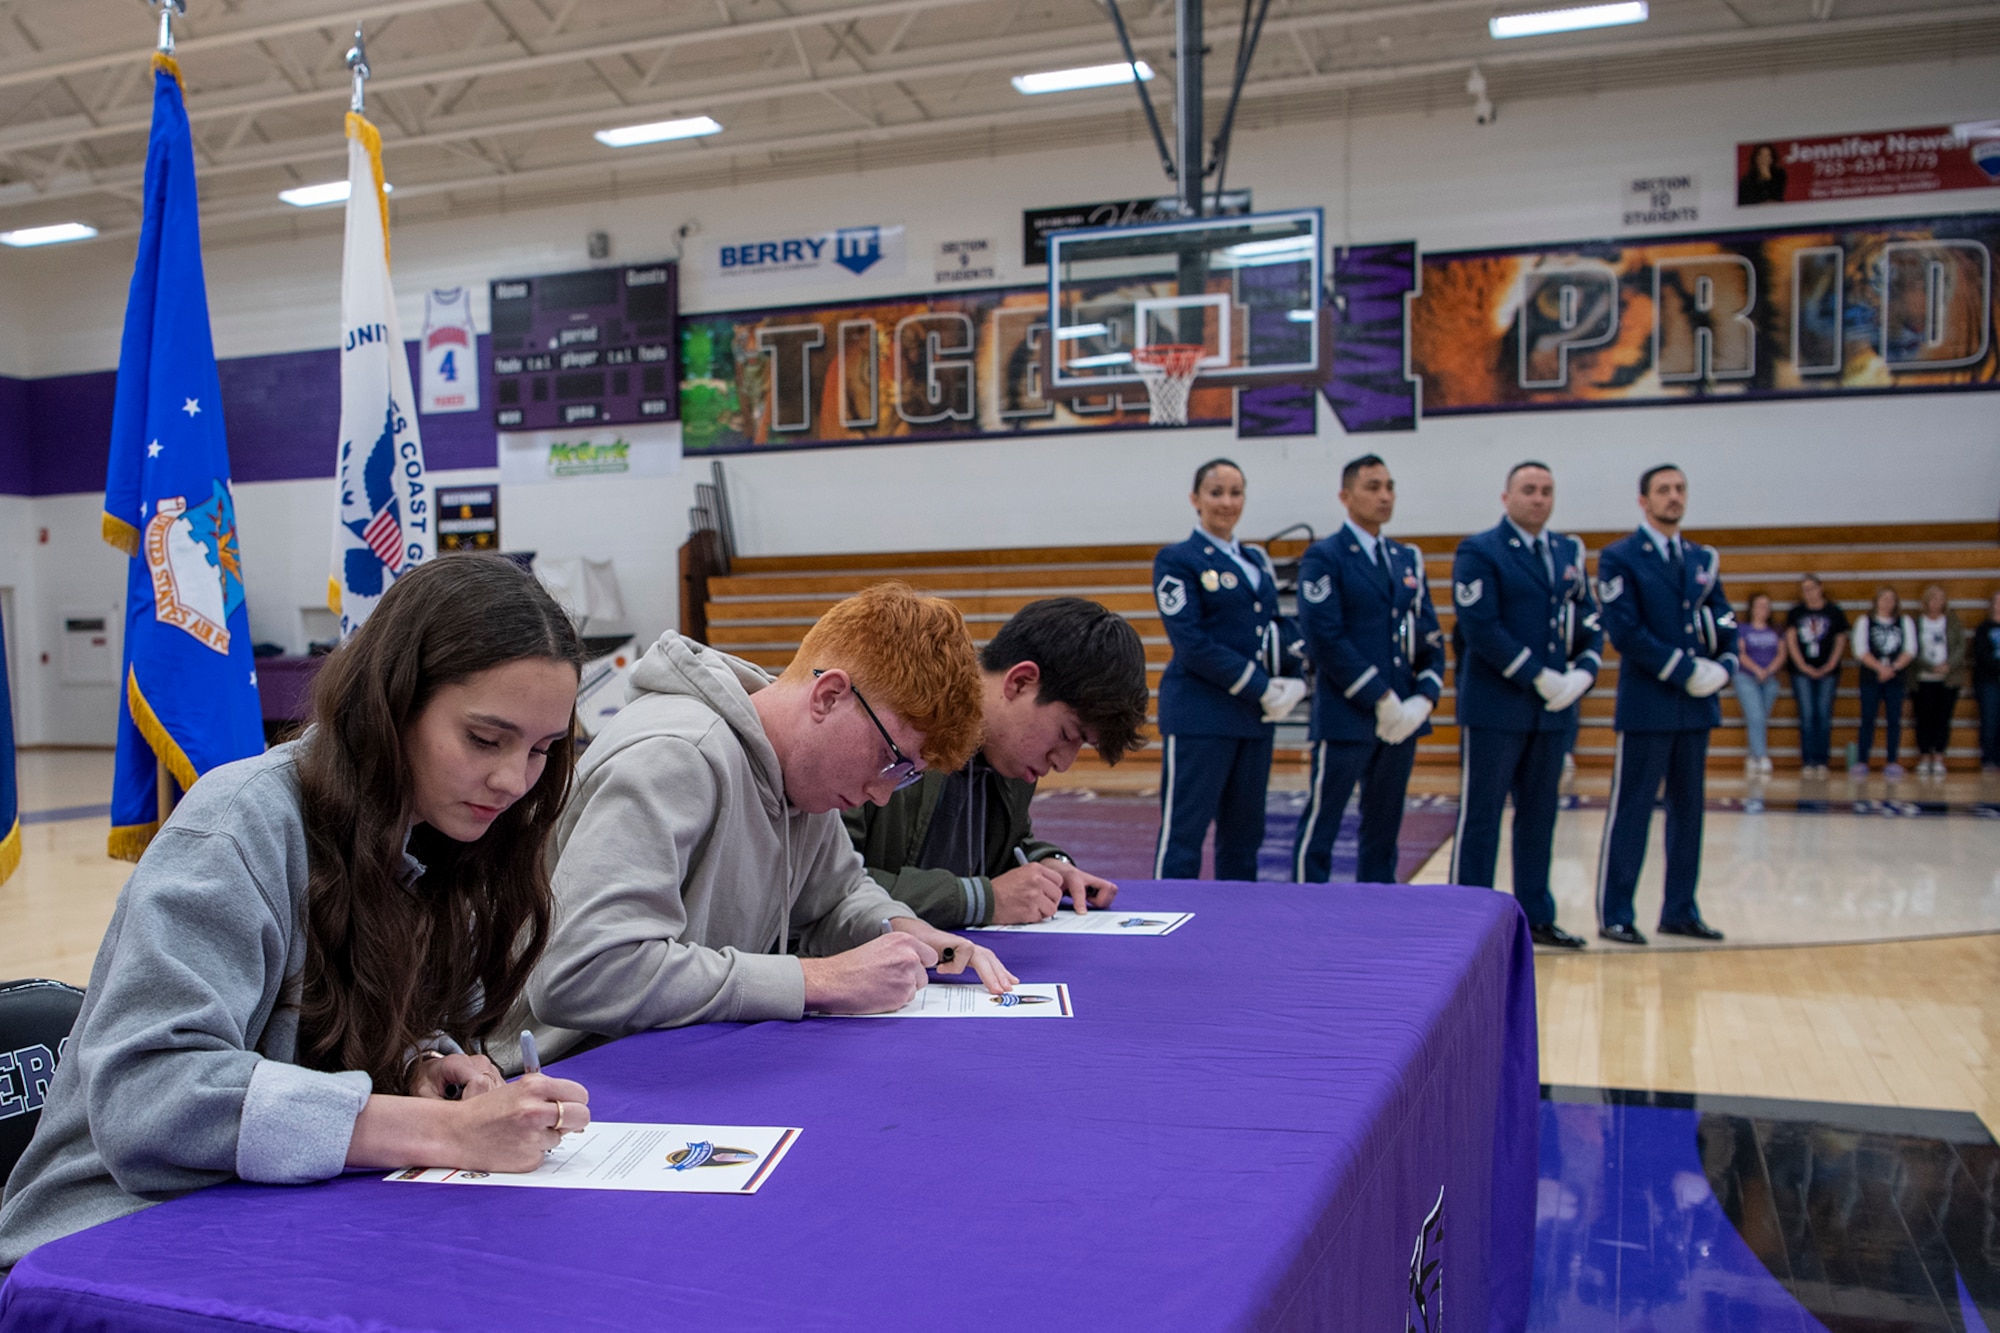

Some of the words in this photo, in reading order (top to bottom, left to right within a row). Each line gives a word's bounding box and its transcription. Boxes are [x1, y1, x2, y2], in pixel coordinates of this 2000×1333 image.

[1784, 138, 1883, 164] Jennifer
[1886, 133, 1969, 153] Newell
[1631, 176, 1691, 193] SECTION
[1622, 206, 1699, 226] STUDENTS
[720, 238, 827, 268] BERRY
[941, 240, 988, 254] SECTION
[935, 267, 995, 283] STUDENTS
[438, 349, 458, 382] 4
[400, 442, 428, 533] COAST
[149, 515, 175, 567] UNITED
[155, 569, 192, 625] STATES
